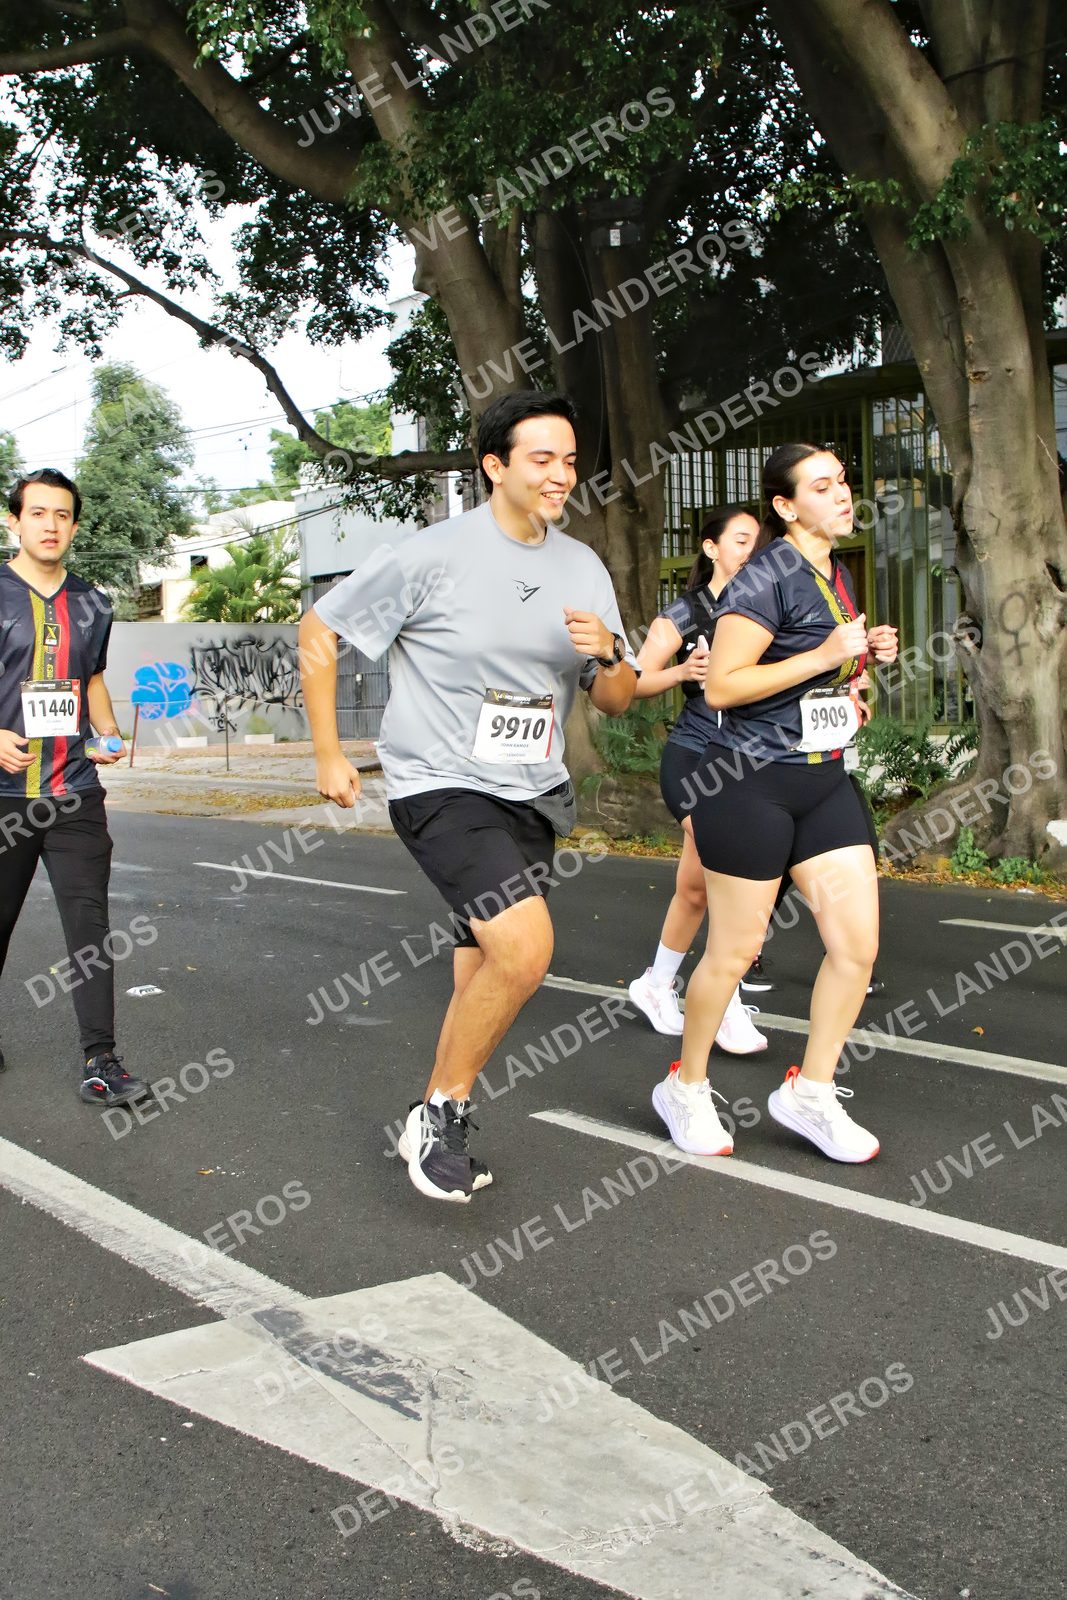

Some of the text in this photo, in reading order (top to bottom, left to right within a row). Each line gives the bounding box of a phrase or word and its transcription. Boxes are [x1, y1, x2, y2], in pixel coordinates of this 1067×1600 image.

[28, 698, 74, 717] 11440
[811, 705, 848, 731] 9909
[490, 714, 546, 740] 9910
